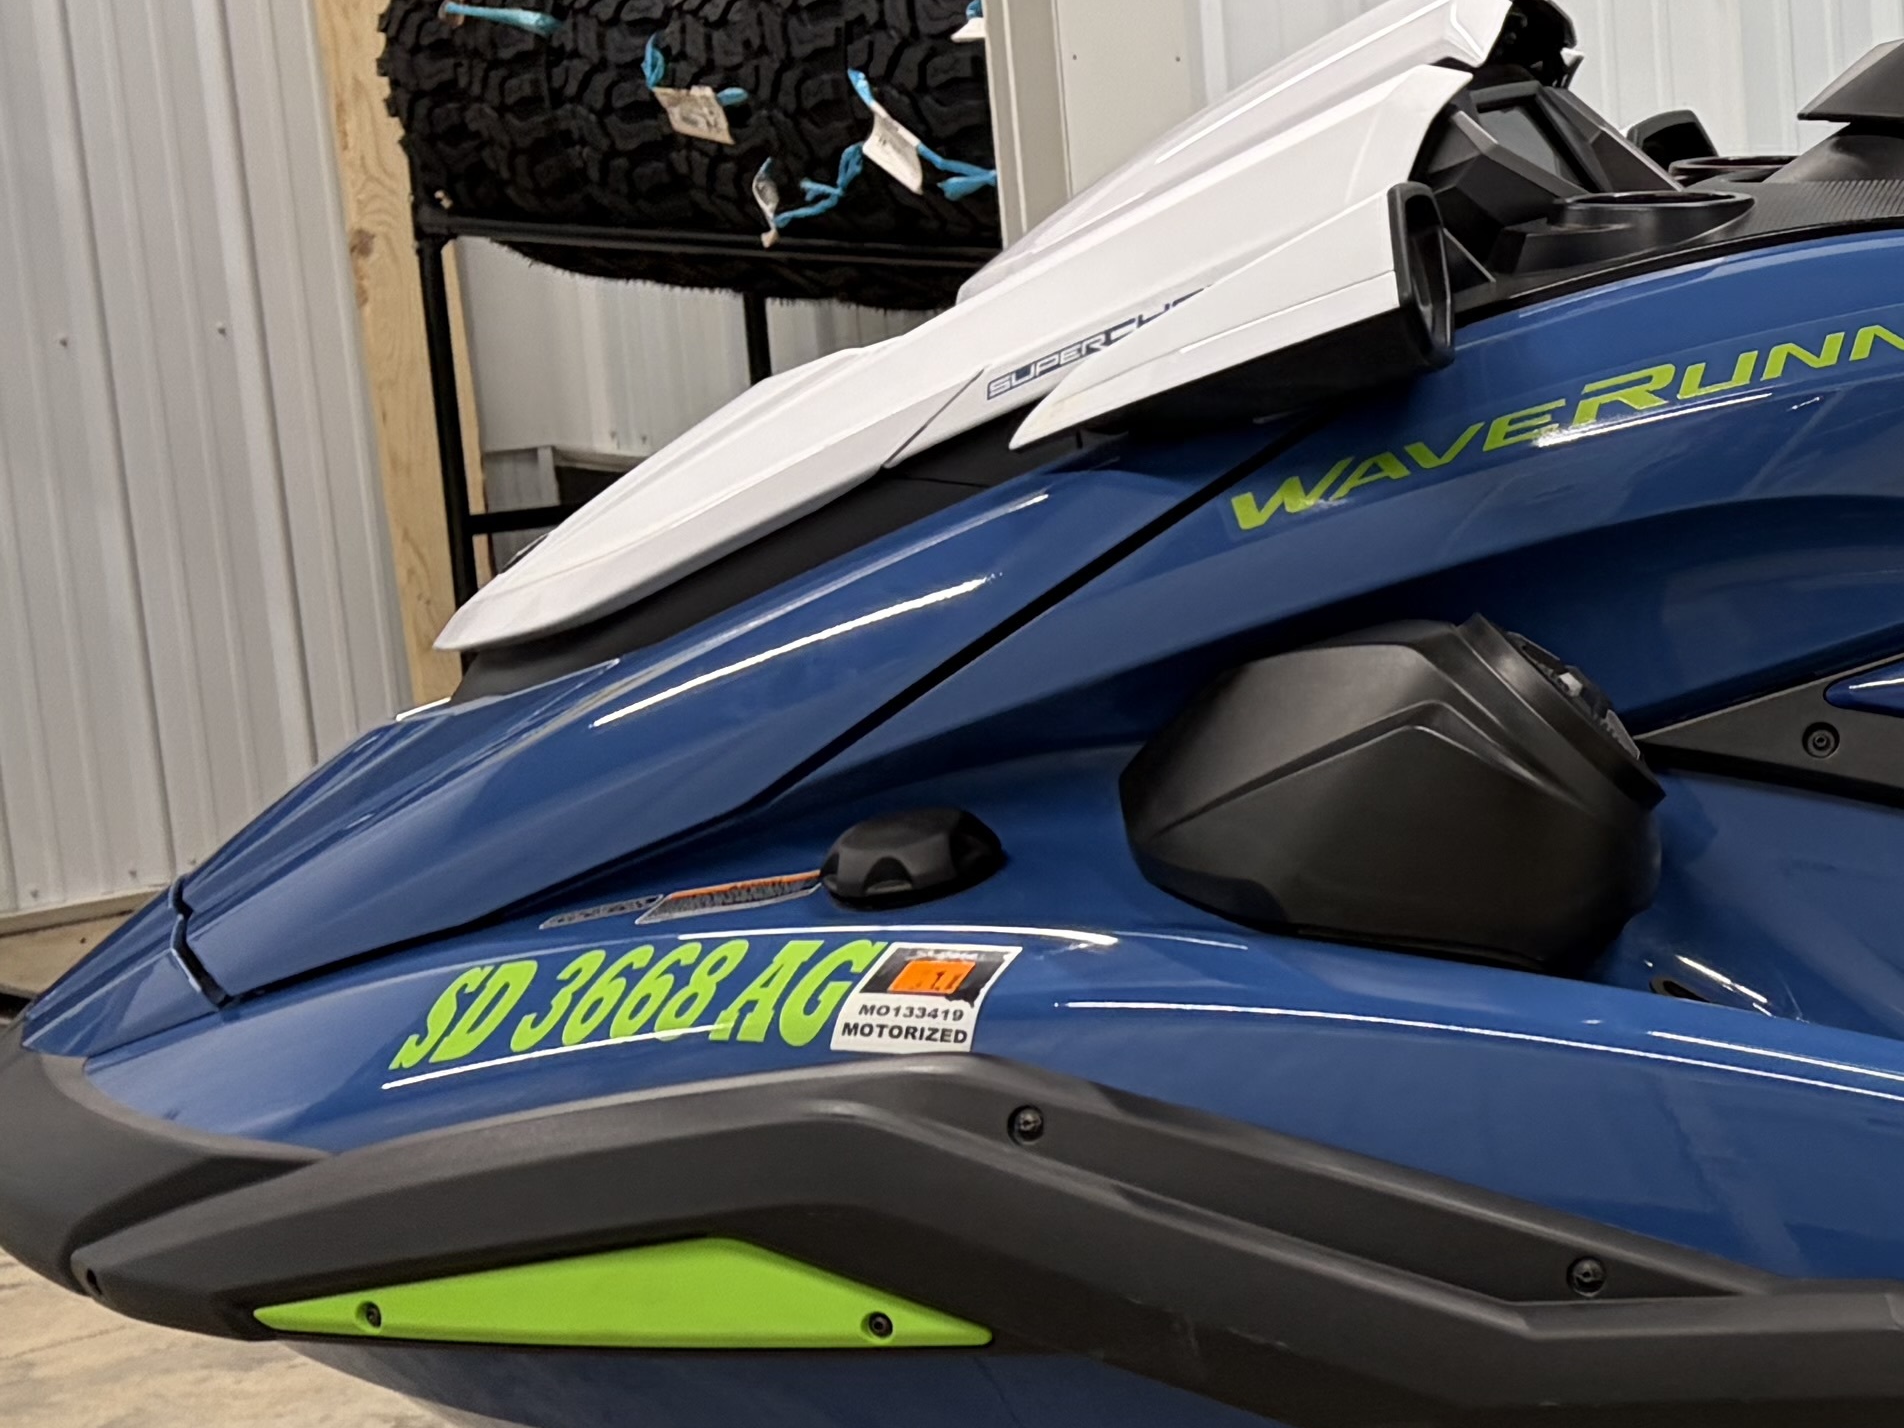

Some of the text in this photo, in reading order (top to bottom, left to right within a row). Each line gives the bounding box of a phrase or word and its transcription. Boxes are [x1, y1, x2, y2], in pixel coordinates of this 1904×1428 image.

[389, 939, 889, 1070] SD 3668 AG
[858, 1004, 965, 1021] MO133419
[841, 1022, 968, 1044] MOTORIZED
